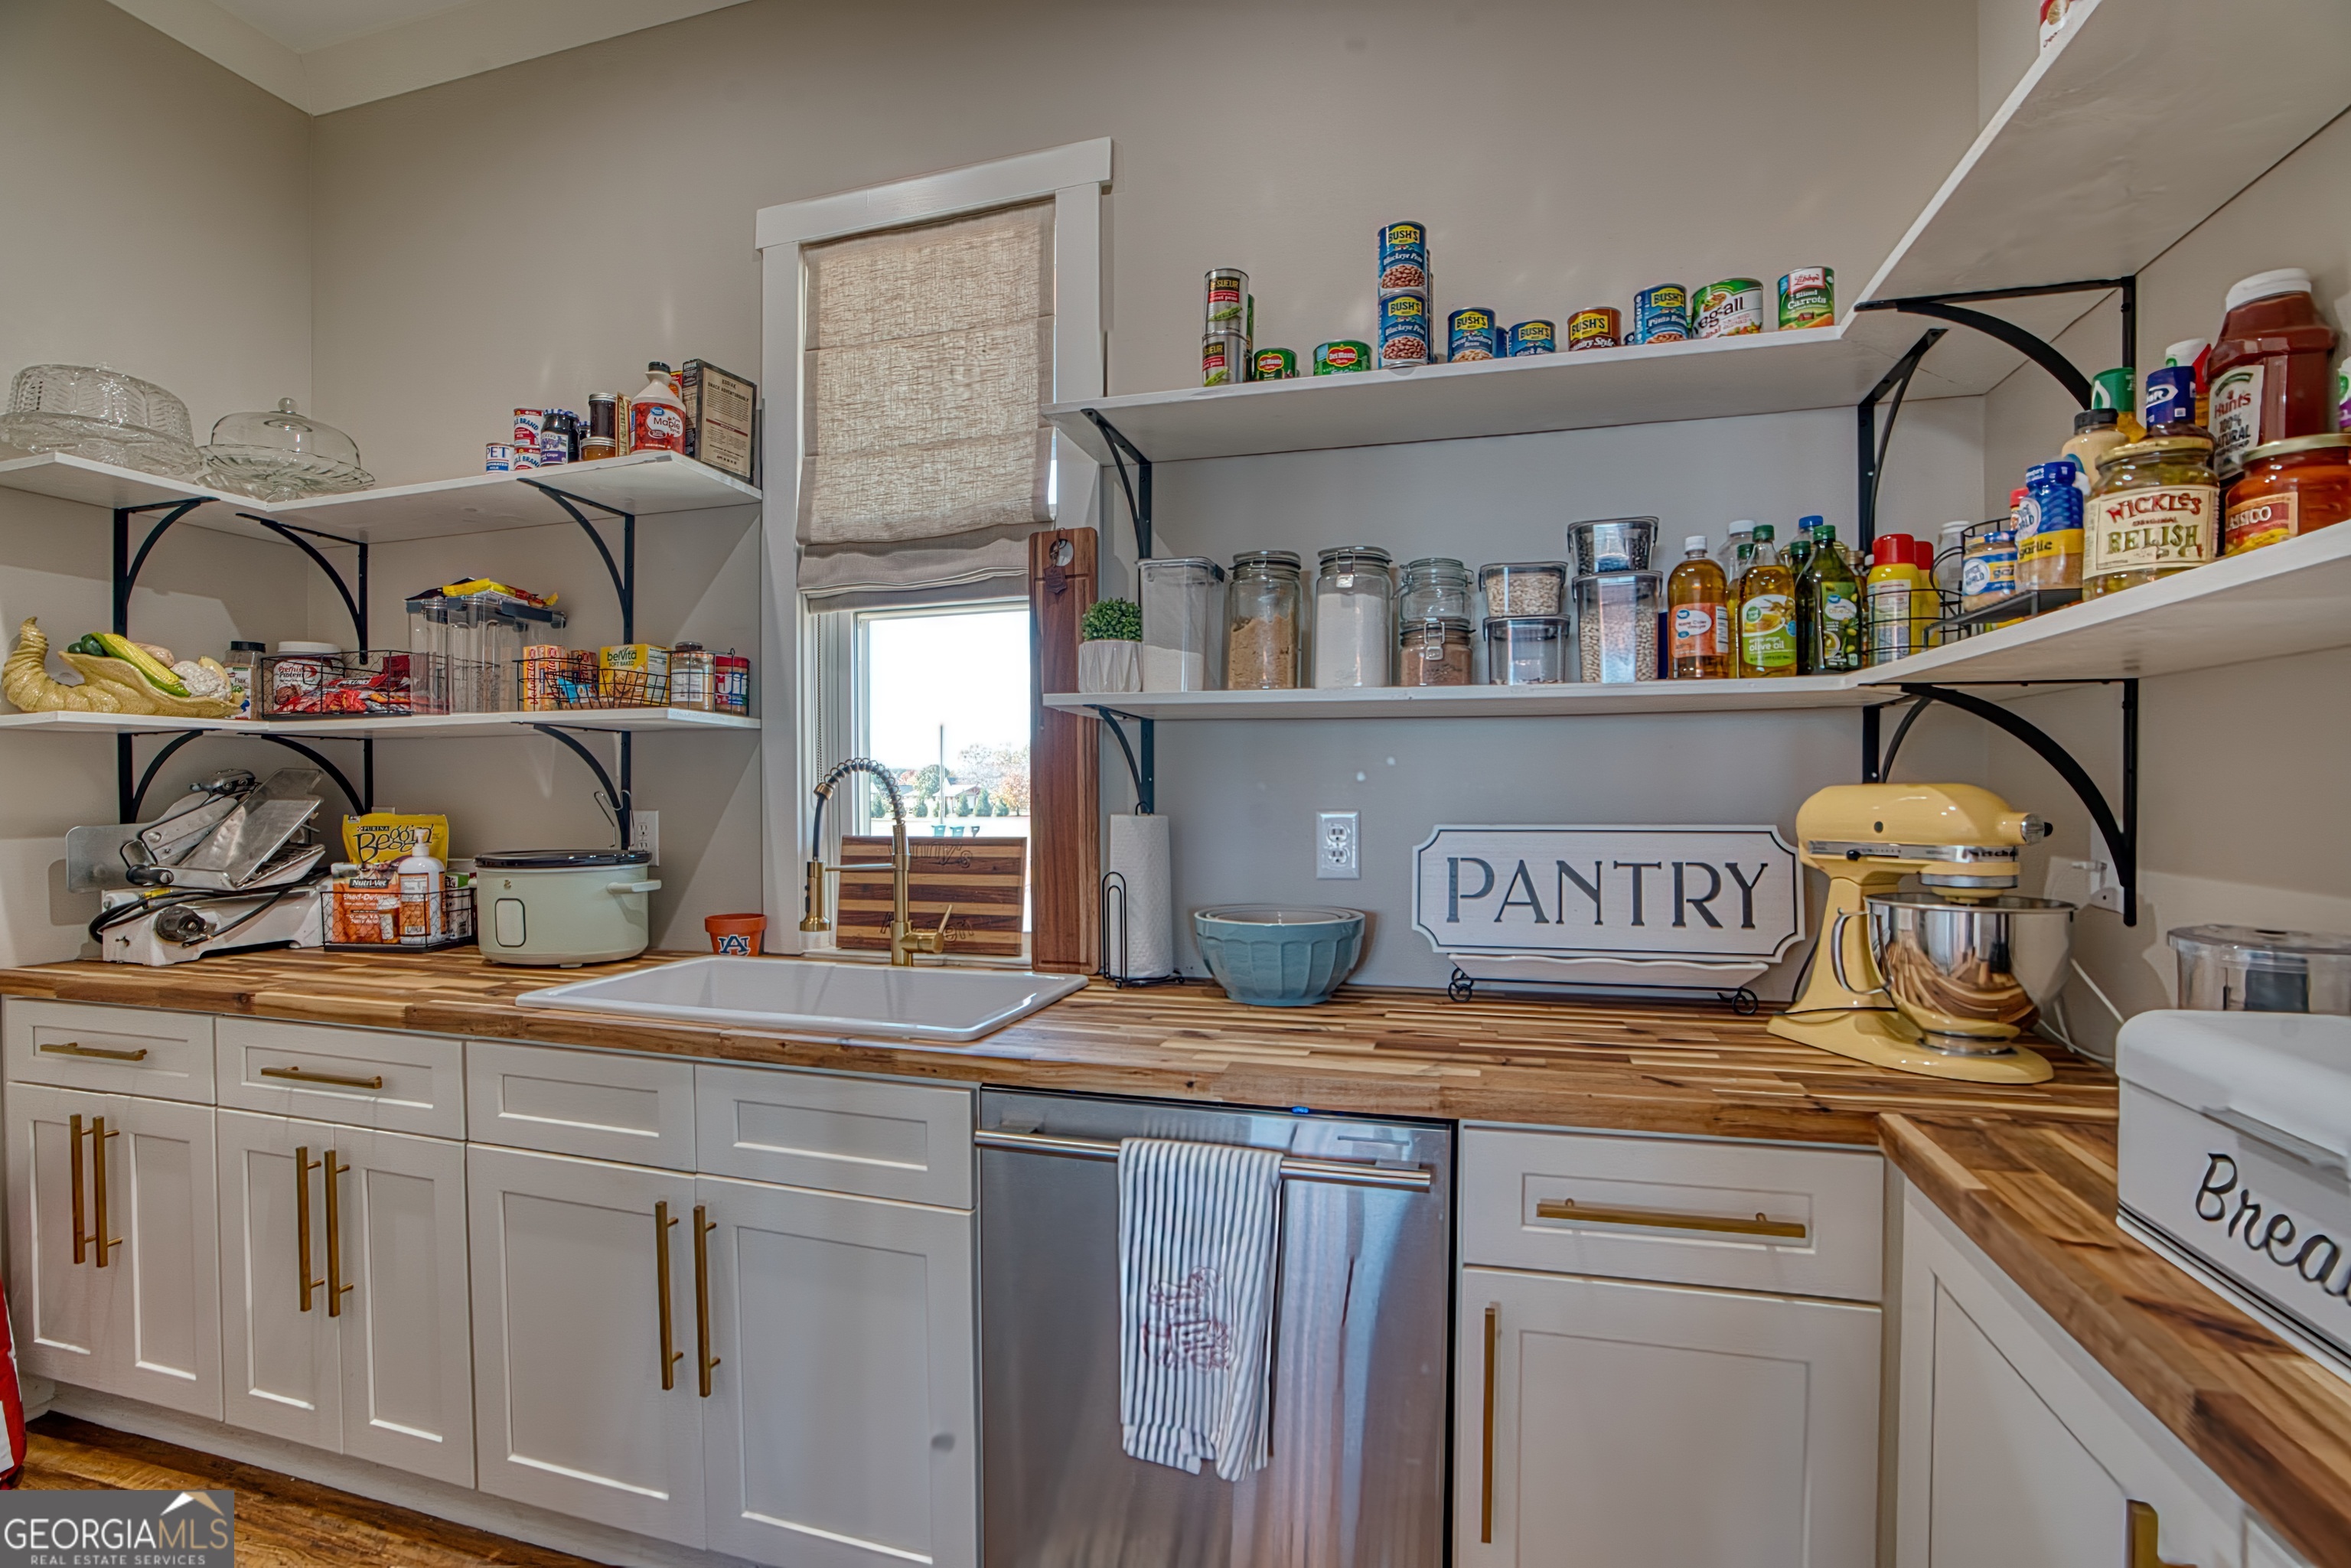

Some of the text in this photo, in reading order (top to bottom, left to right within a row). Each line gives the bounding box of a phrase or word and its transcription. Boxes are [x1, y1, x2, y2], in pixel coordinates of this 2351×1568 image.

[1388, 230, 1419, 243] BUSH'S
[1795, 289, 1818, 299] Sliced
[1391, 302, 1420, 314] BUSH'S
[1788, 295, 1827, 309] Carrots
[1456, 315, 1486, 329] BUSH'S
[1572, 318, 1606, 337] BUSH'S
[1521, 327, 1550, 338] BUSH'S
[2214, 392, 2252, 419] Hunt's
[520, 417, 539, 430] BRAND
[654, 417, 680, 430] Maple
[486, 446, 510, 458] PET
[2106, 524, 2199, 555] RELISH
[2019, 540, 2053, 559] garlic
[1749, 640, 1785, 651] olive oil
[607, 647, 637, 661] belVita
[1446, 856, 1769, 930] PANTRY
[2195, 1152, 2351, 1307] Brea
